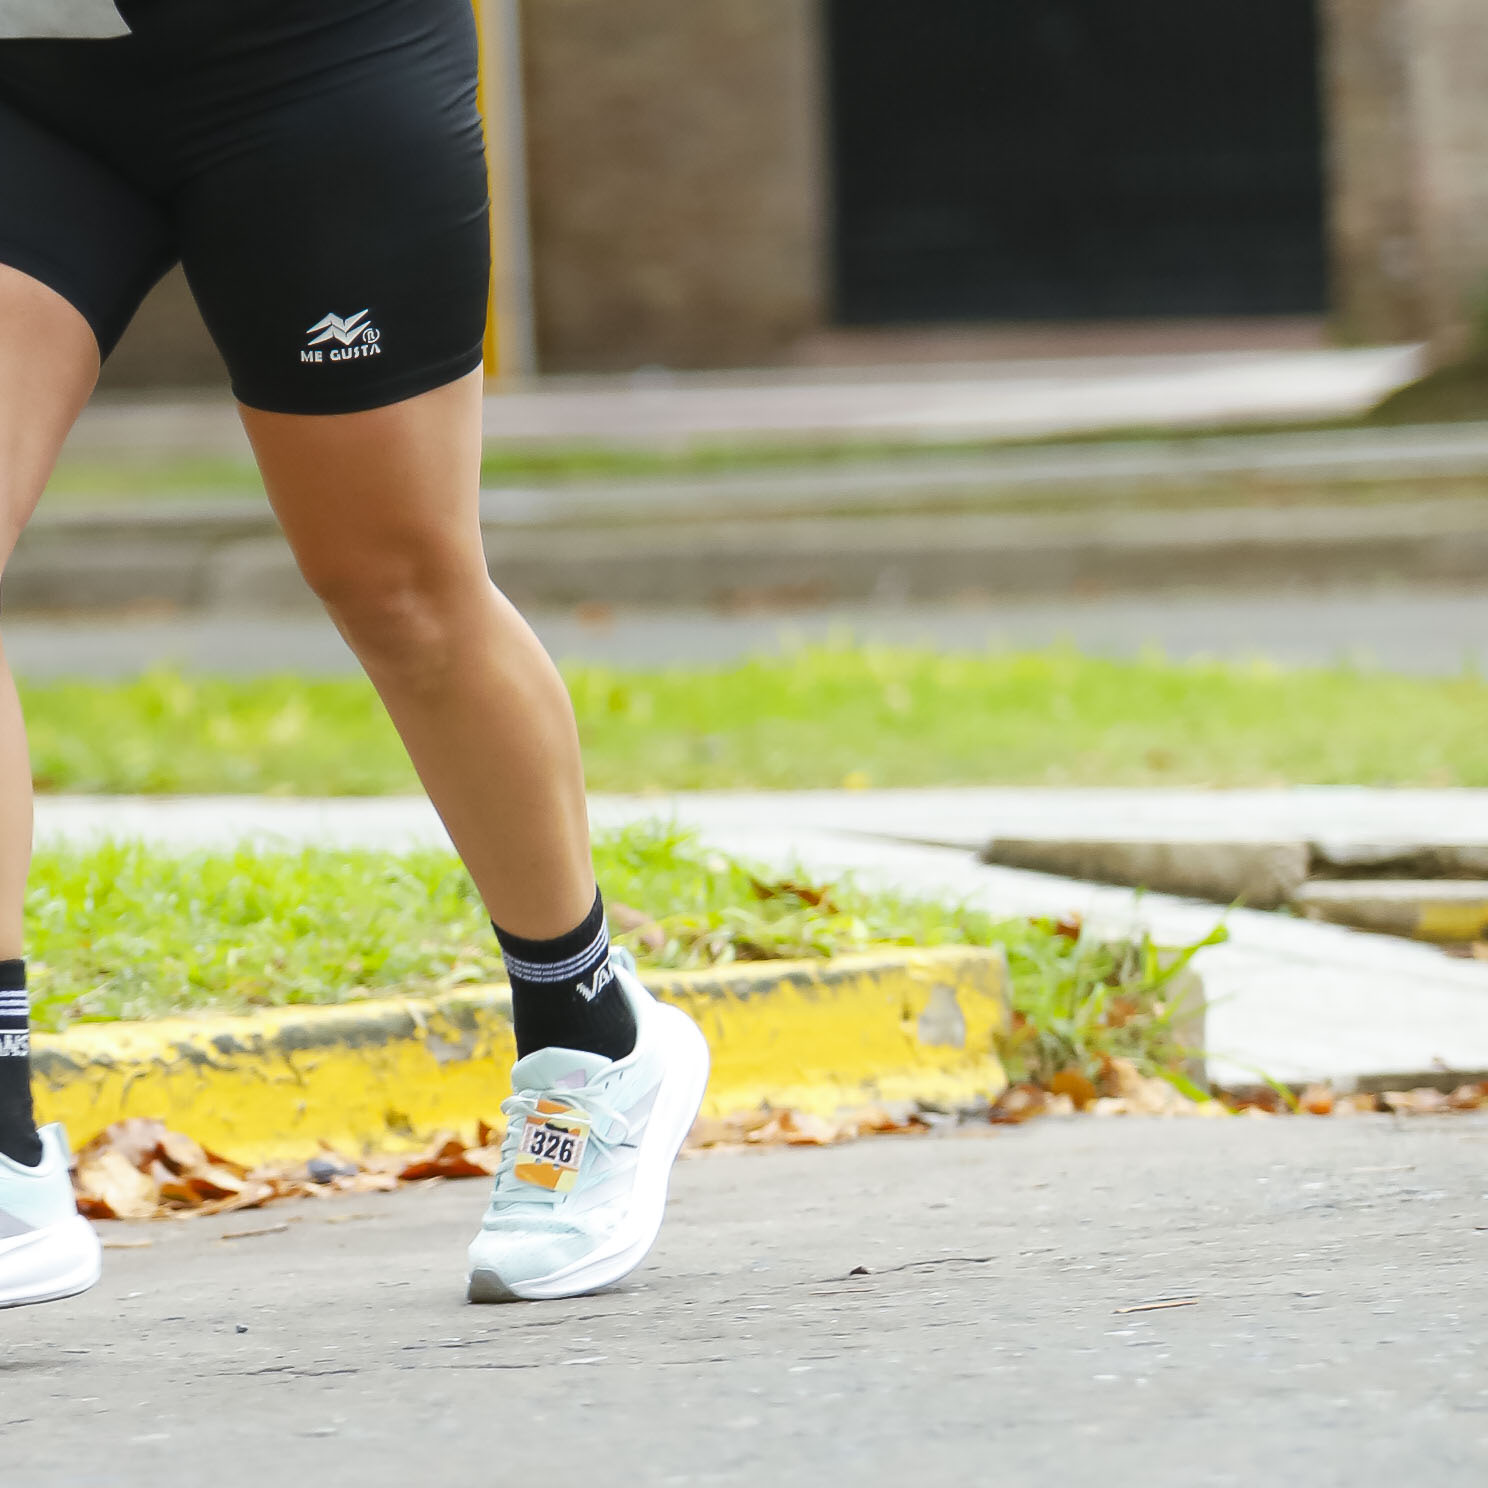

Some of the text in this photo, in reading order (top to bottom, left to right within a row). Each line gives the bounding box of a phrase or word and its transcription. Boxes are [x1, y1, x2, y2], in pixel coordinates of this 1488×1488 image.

[300, 343, 381, 363] ME GUSTA
[576, 953, 614, 1002] VA
[530, 1130, 575, 1163] 326
